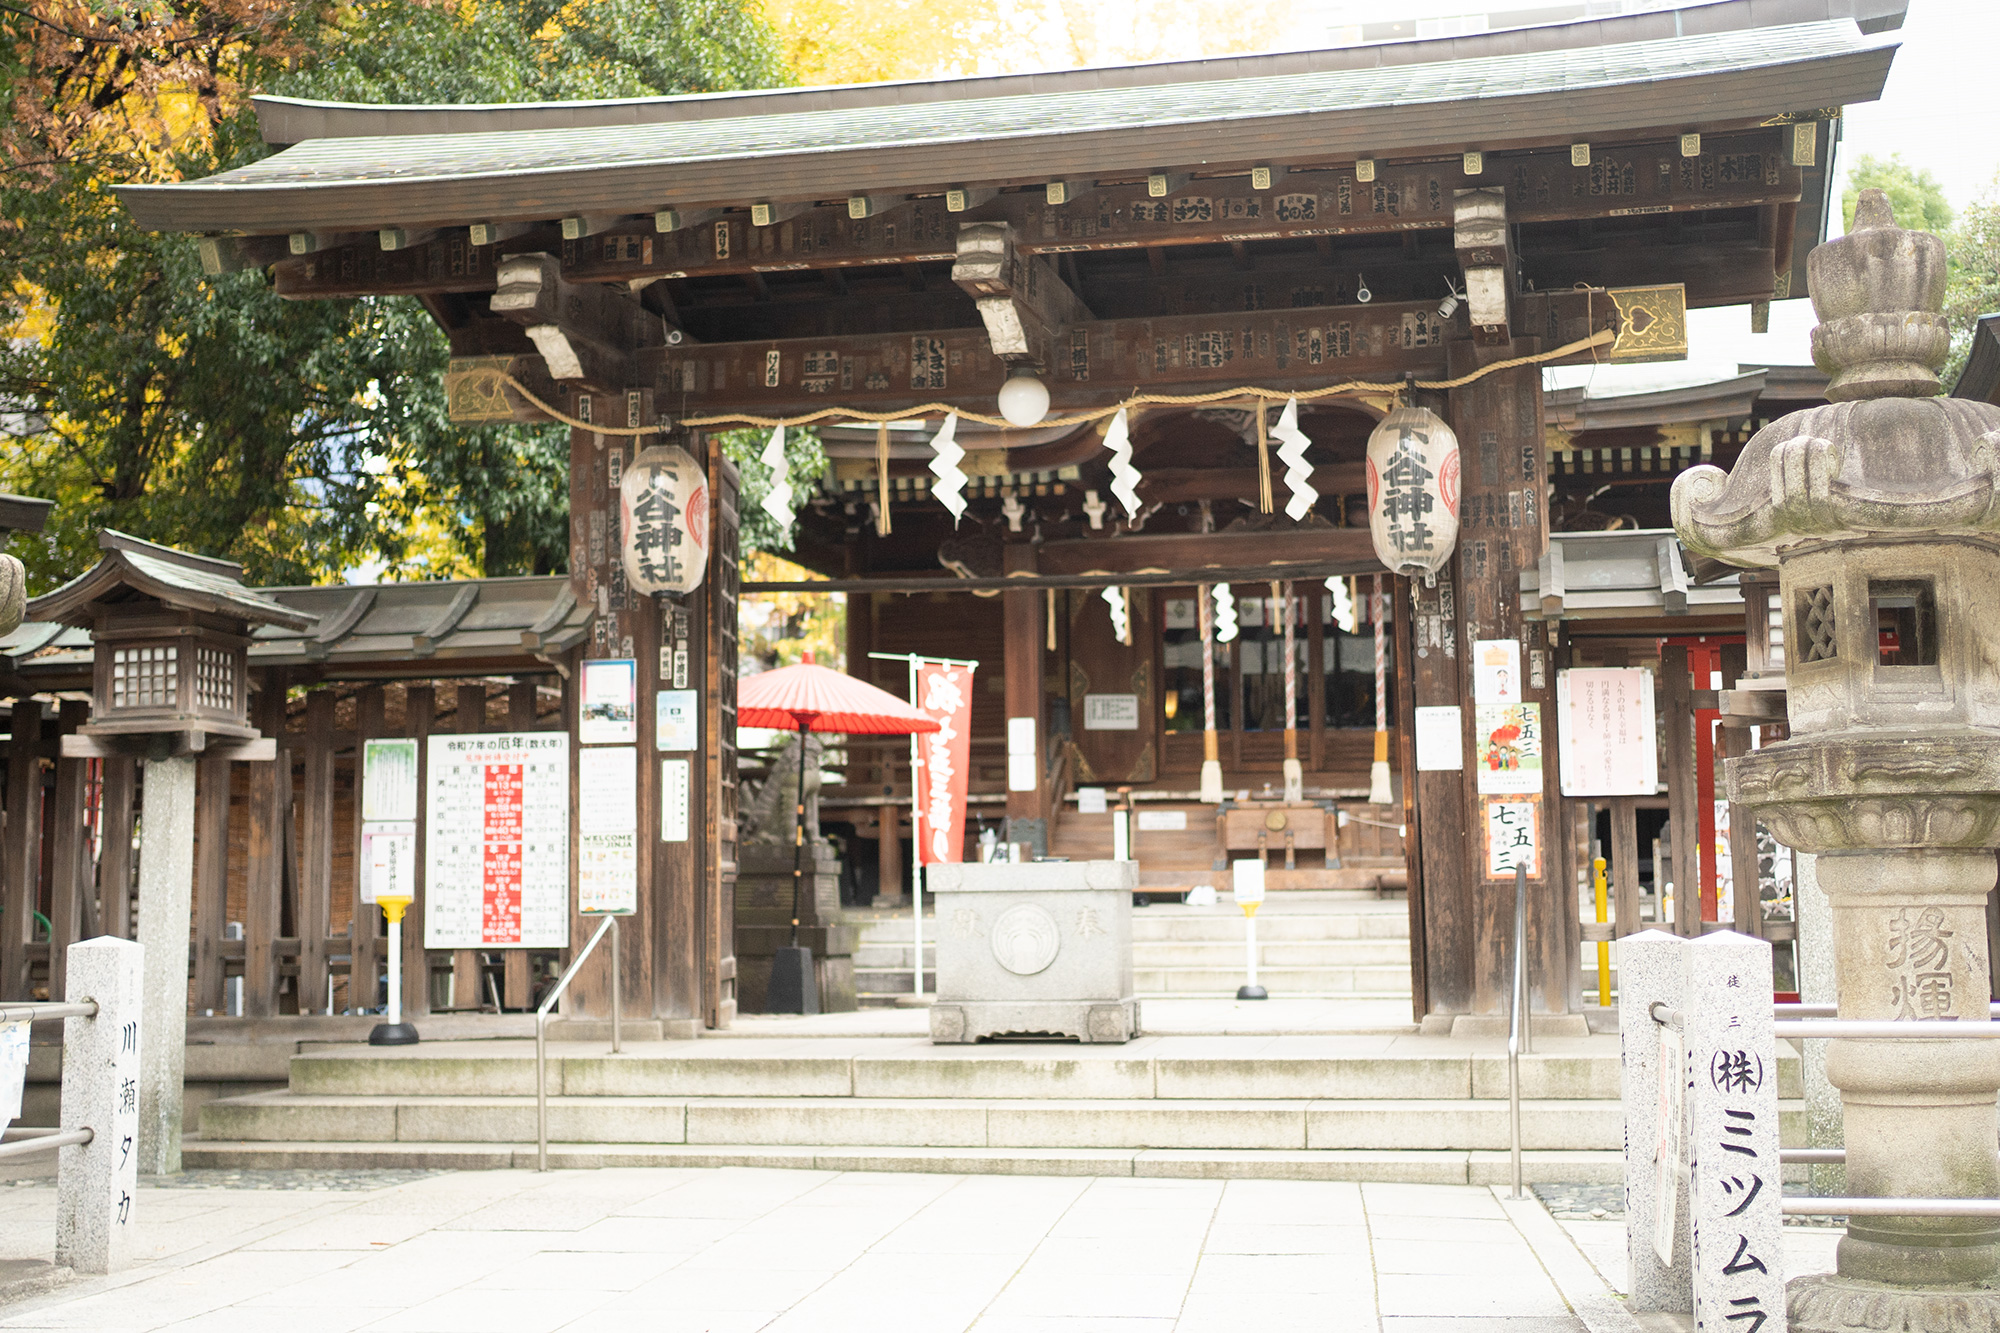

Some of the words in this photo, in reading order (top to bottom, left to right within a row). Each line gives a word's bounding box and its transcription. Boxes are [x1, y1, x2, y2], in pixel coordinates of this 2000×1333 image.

[634, 461, 684, 584] 下谷神社
[1382, 422, 1435, 552] 下谷神社
[1517, 706, 1537, 758] 七五三
